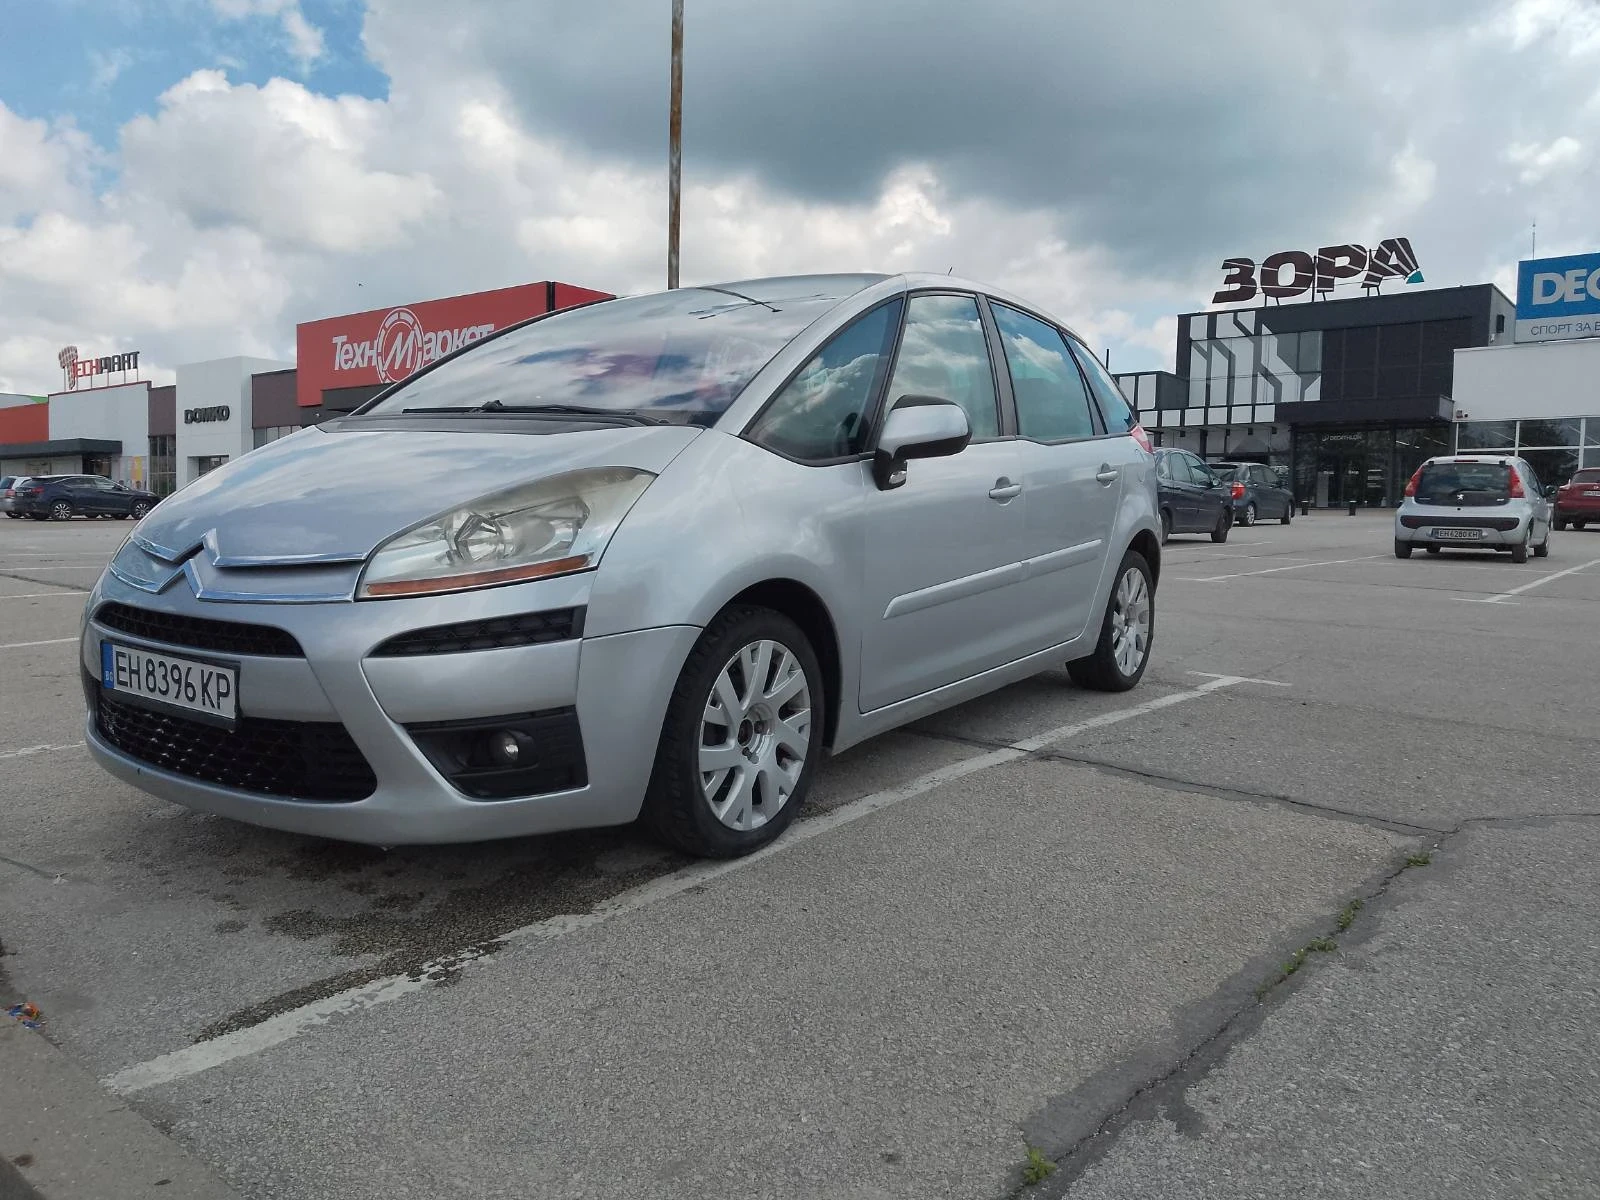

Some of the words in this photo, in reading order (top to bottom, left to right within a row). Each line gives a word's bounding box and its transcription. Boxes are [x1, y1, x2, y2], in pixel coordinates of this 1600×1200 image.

[1212, 237, 1424, 304] ЗОРА
[1531, 323, 1573, 336] СПОРТ
[1575, 321, 1592, 333] ЗА
